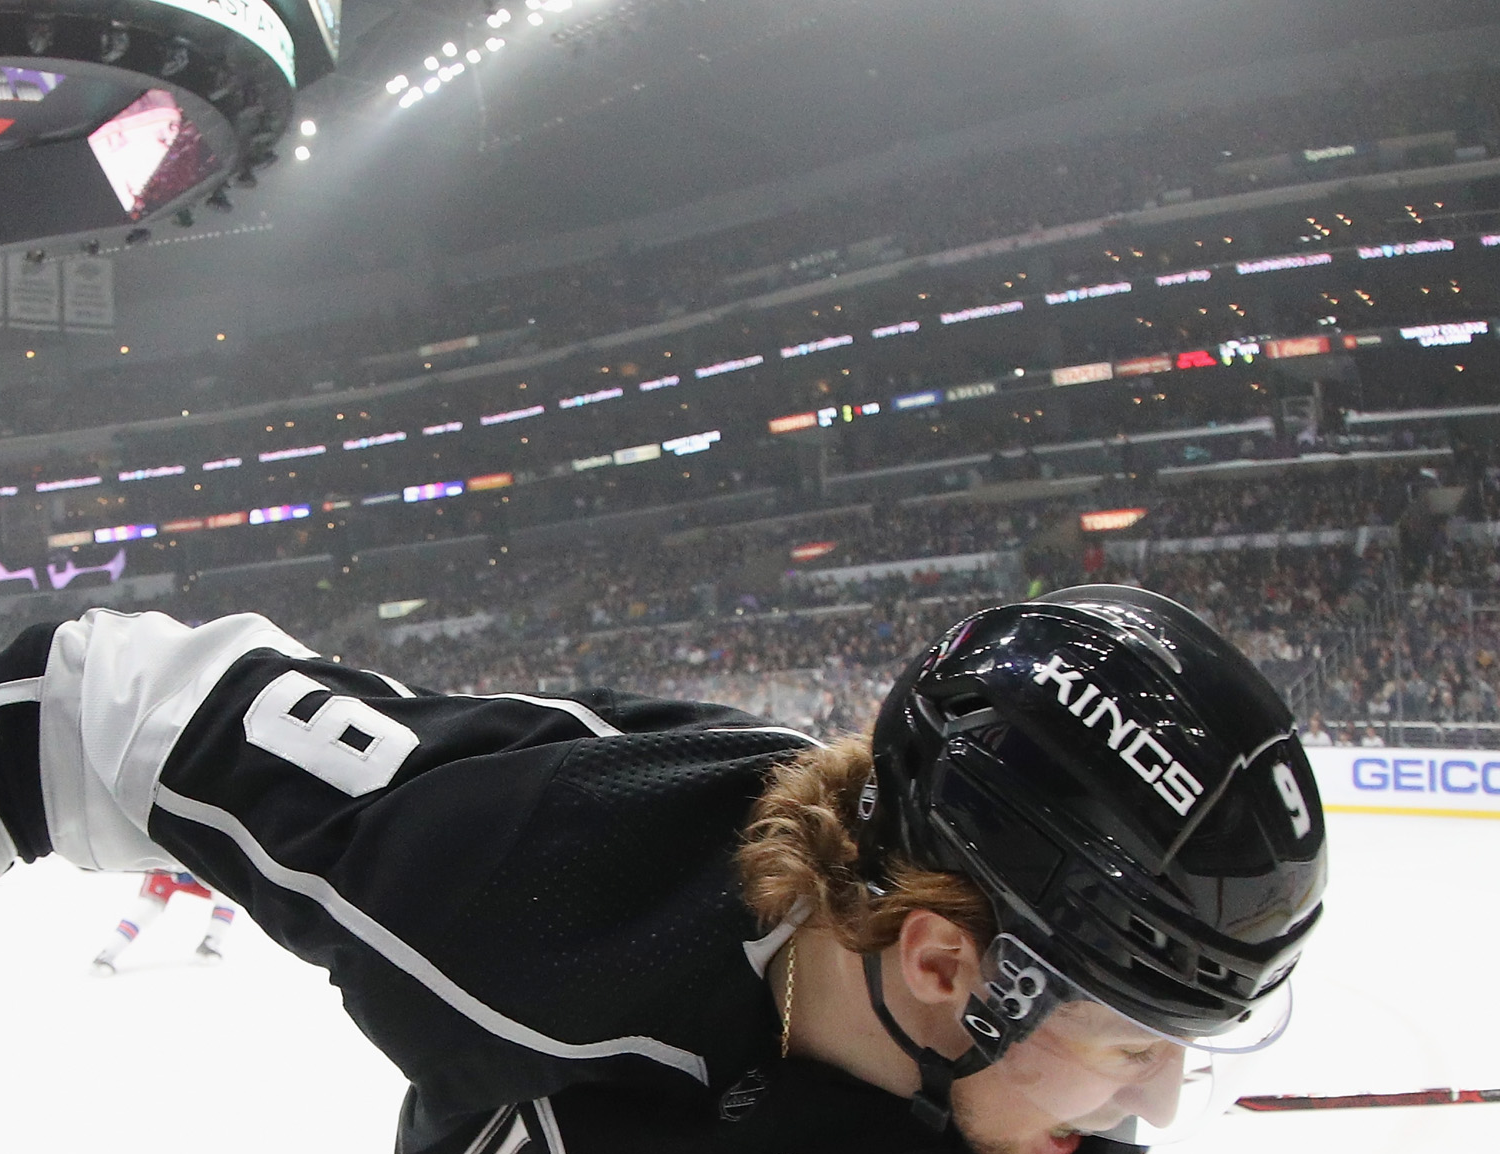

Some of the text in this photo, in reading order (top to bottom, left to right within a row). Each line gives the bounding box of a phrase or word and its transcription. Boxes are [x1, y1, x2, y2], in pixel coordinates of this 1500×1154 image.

[243, 669, 420, 798] 9
[1033, 655, 1205, 817] KINGS
[1273, 761, 1311, 840] 9
